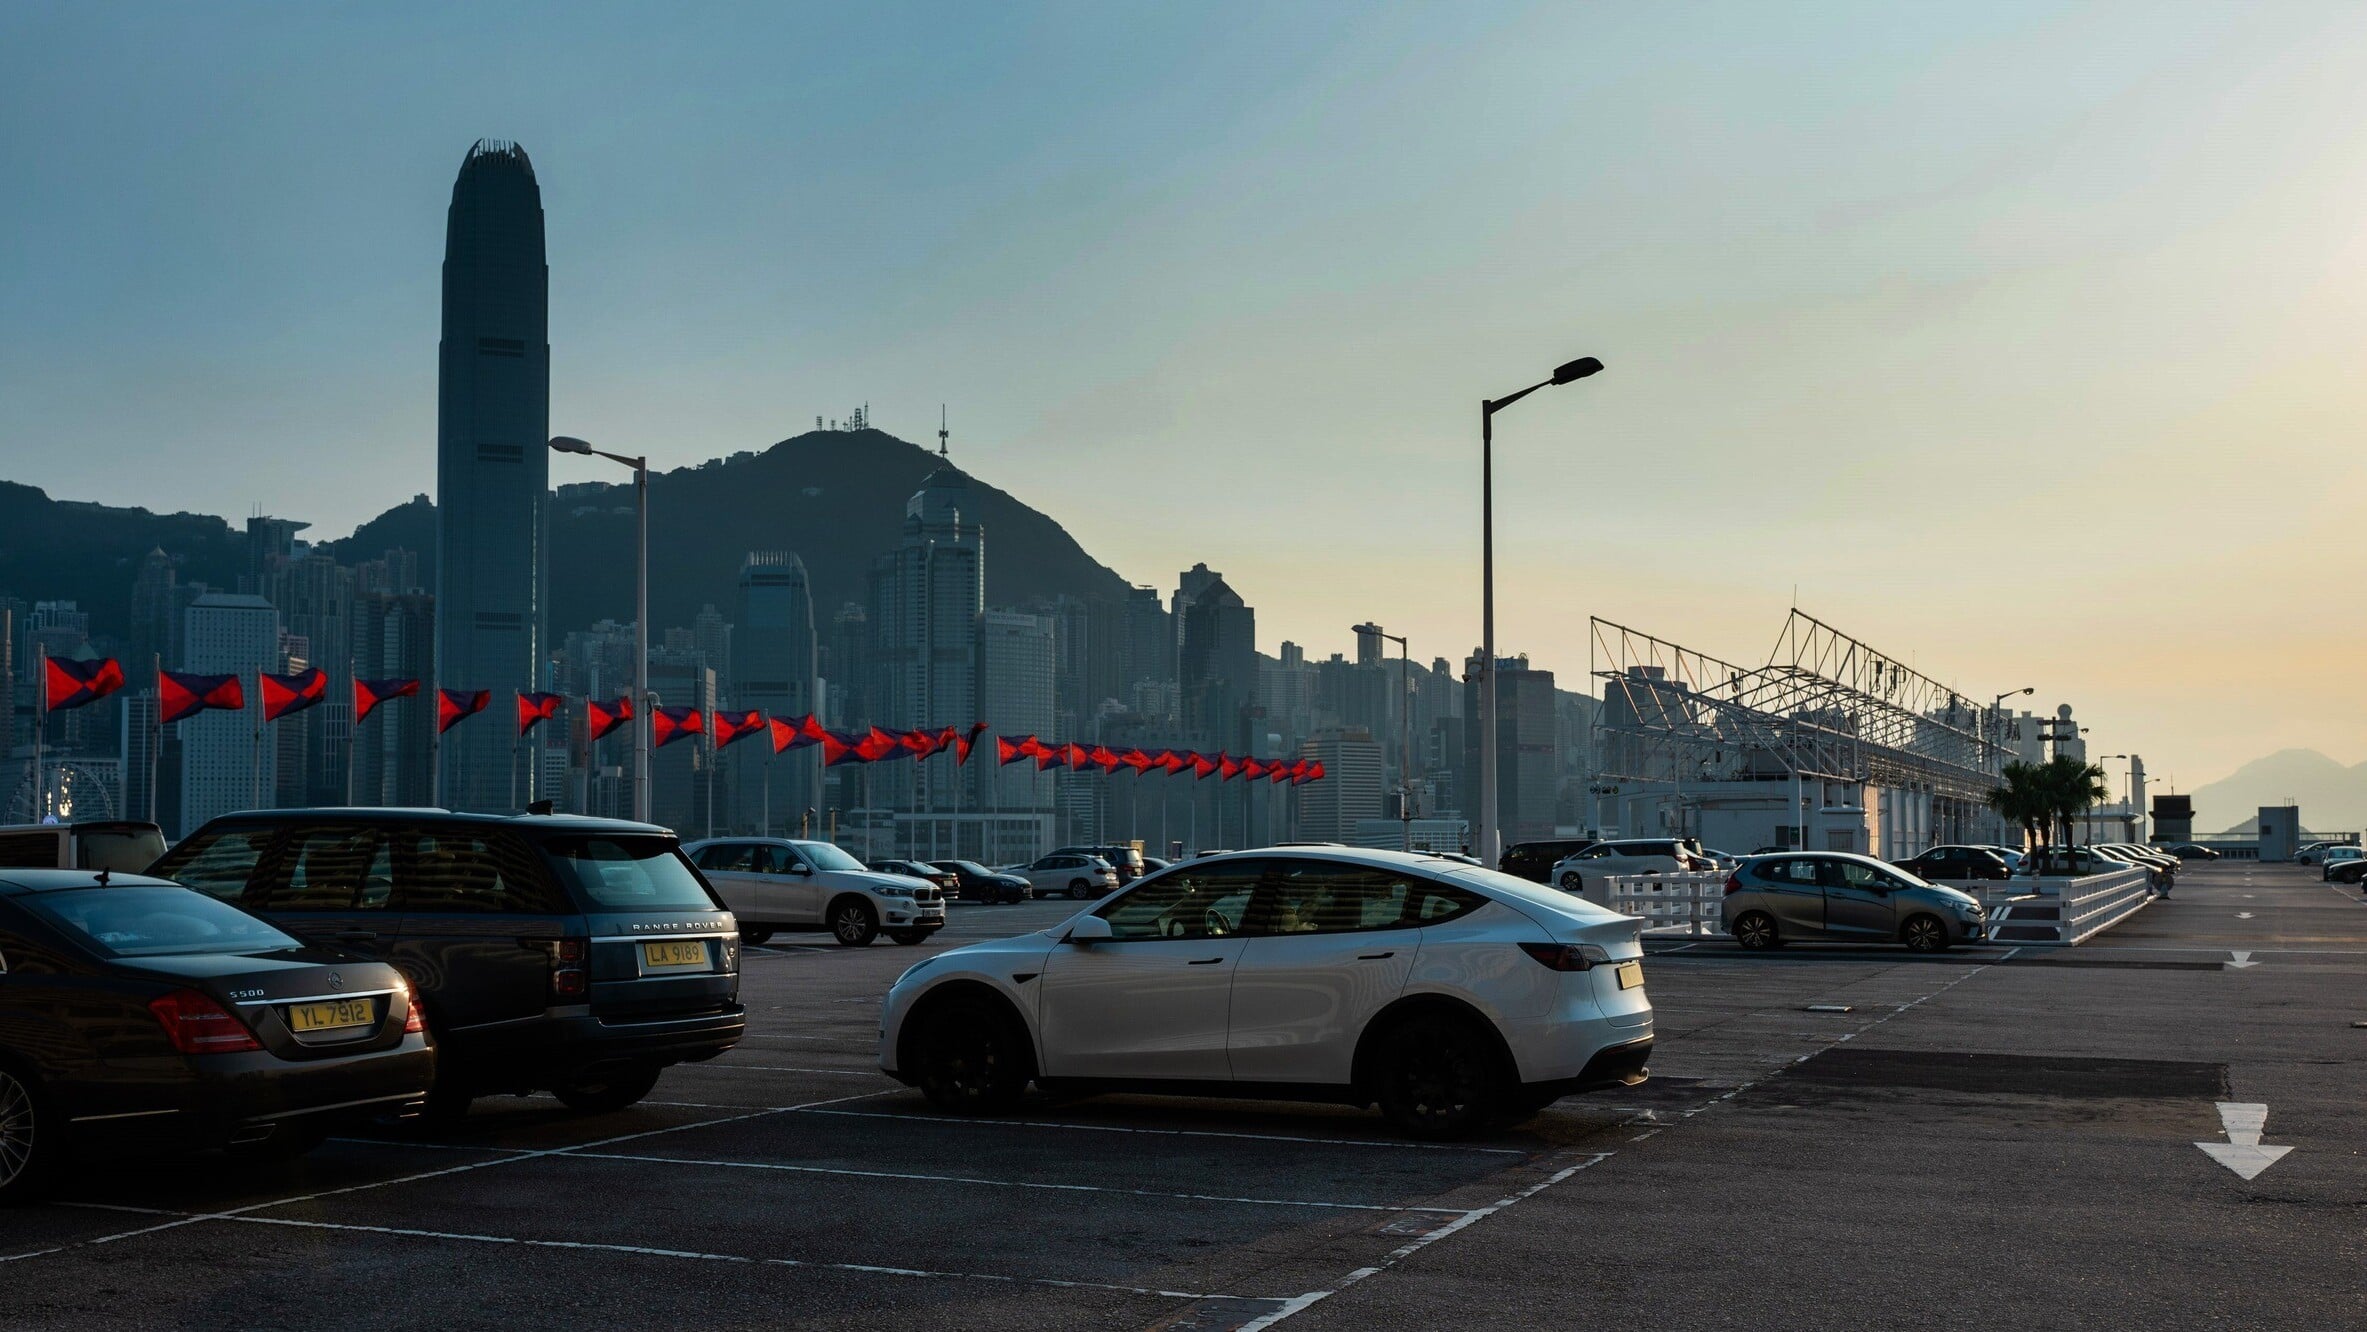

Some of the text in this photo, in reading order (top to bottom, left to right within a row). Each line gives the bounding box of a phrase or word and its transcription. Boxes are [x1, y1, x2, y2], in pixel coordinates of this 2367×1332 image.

[632, 921, 723, 931] RANGE ROVER
[650, 945, 699, 962] LA 9189
[301, 1003, 366, 1026] YL 7912
